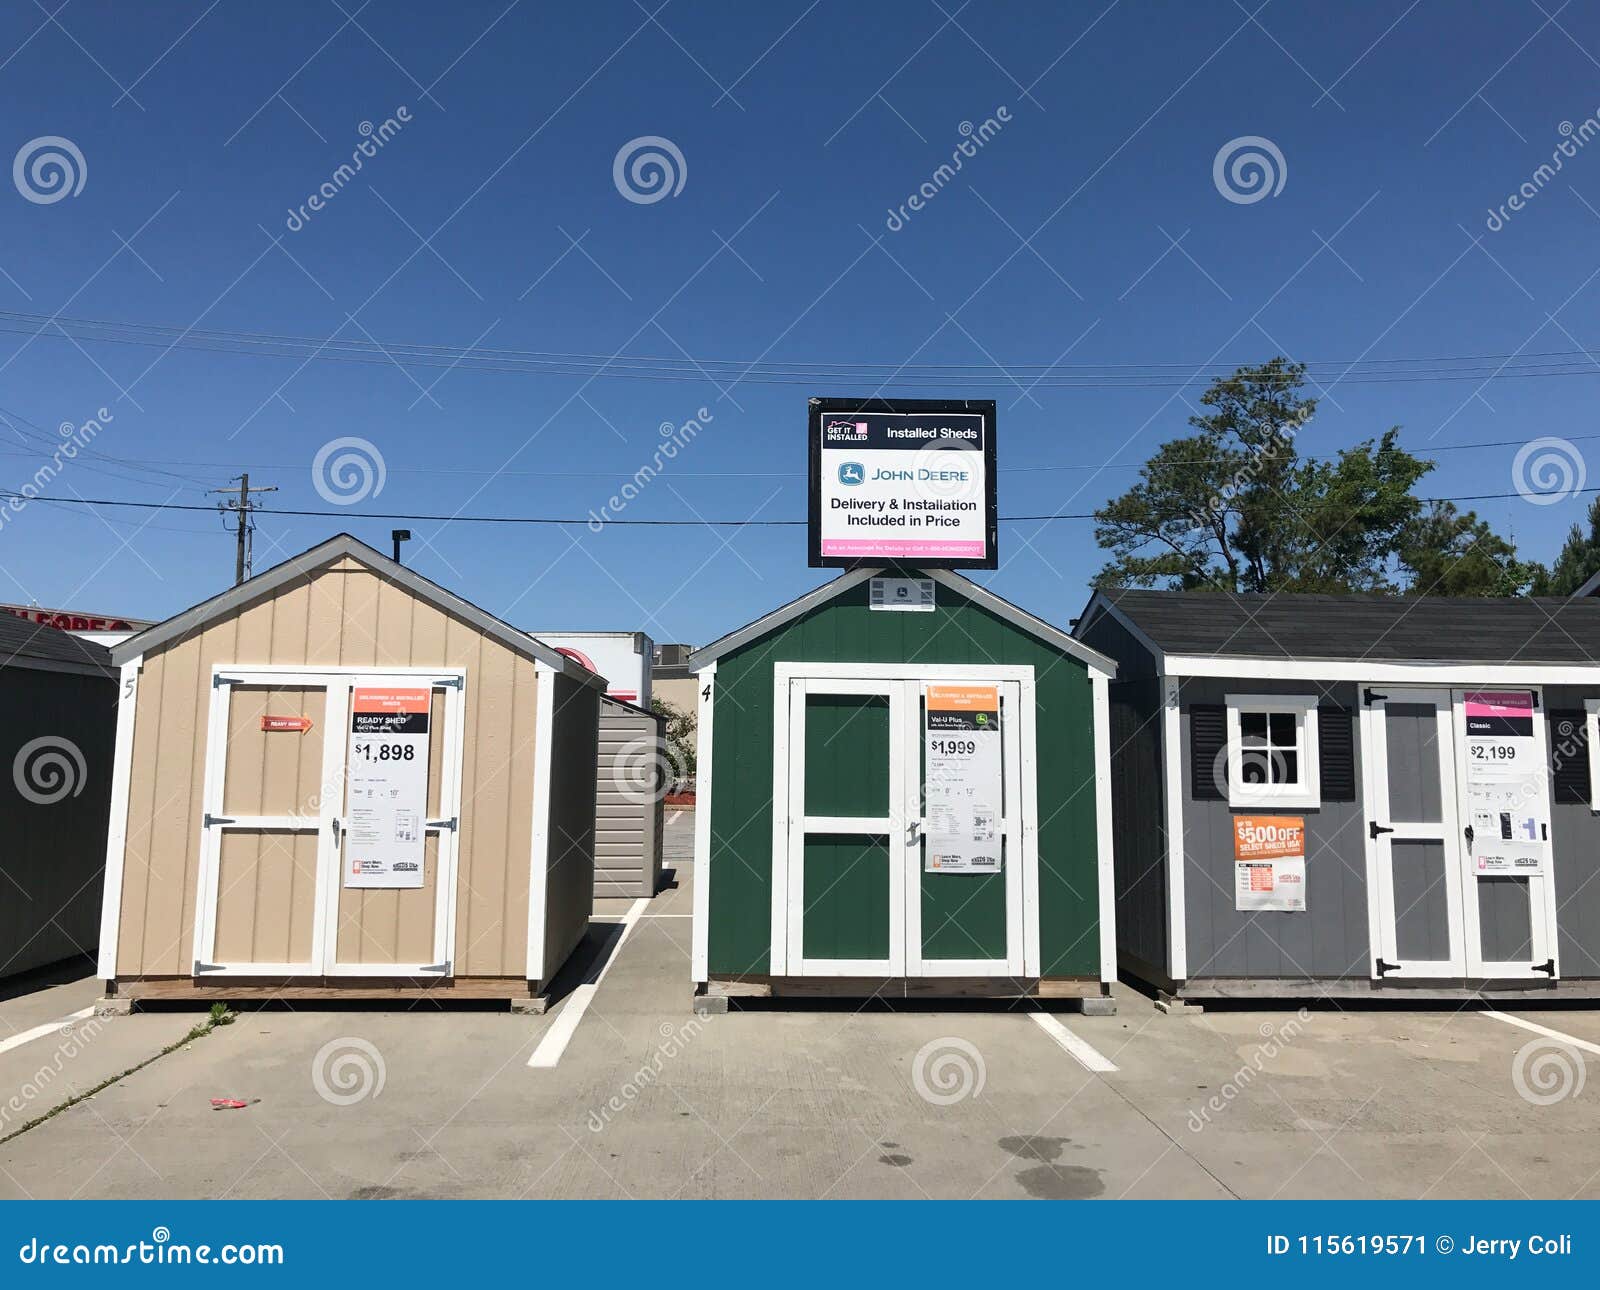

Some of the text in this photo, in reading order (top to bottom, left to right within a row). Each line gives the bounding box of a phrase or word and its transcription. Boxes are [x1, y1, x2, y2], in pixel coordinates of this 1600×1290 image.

[887, 427, 978, 439] Installed Sheds
[872, 469, 968, 481] JOHN DEERE
[830, 498, 977, 512] Delivery & Installation
[847, 514, 960, 526] Included in Price
[124, 678, 136, 699] 5
[702, 684, 710, 702] 4
[355, 744, 414, 763] $1,898
[932, 740, 975, 756] $1,999
[1471, 746, 1515, 760] $2,199
[1238, 826, 1300, 844] $500 OFF
[1240, 843, 1262, 851] SELECT
